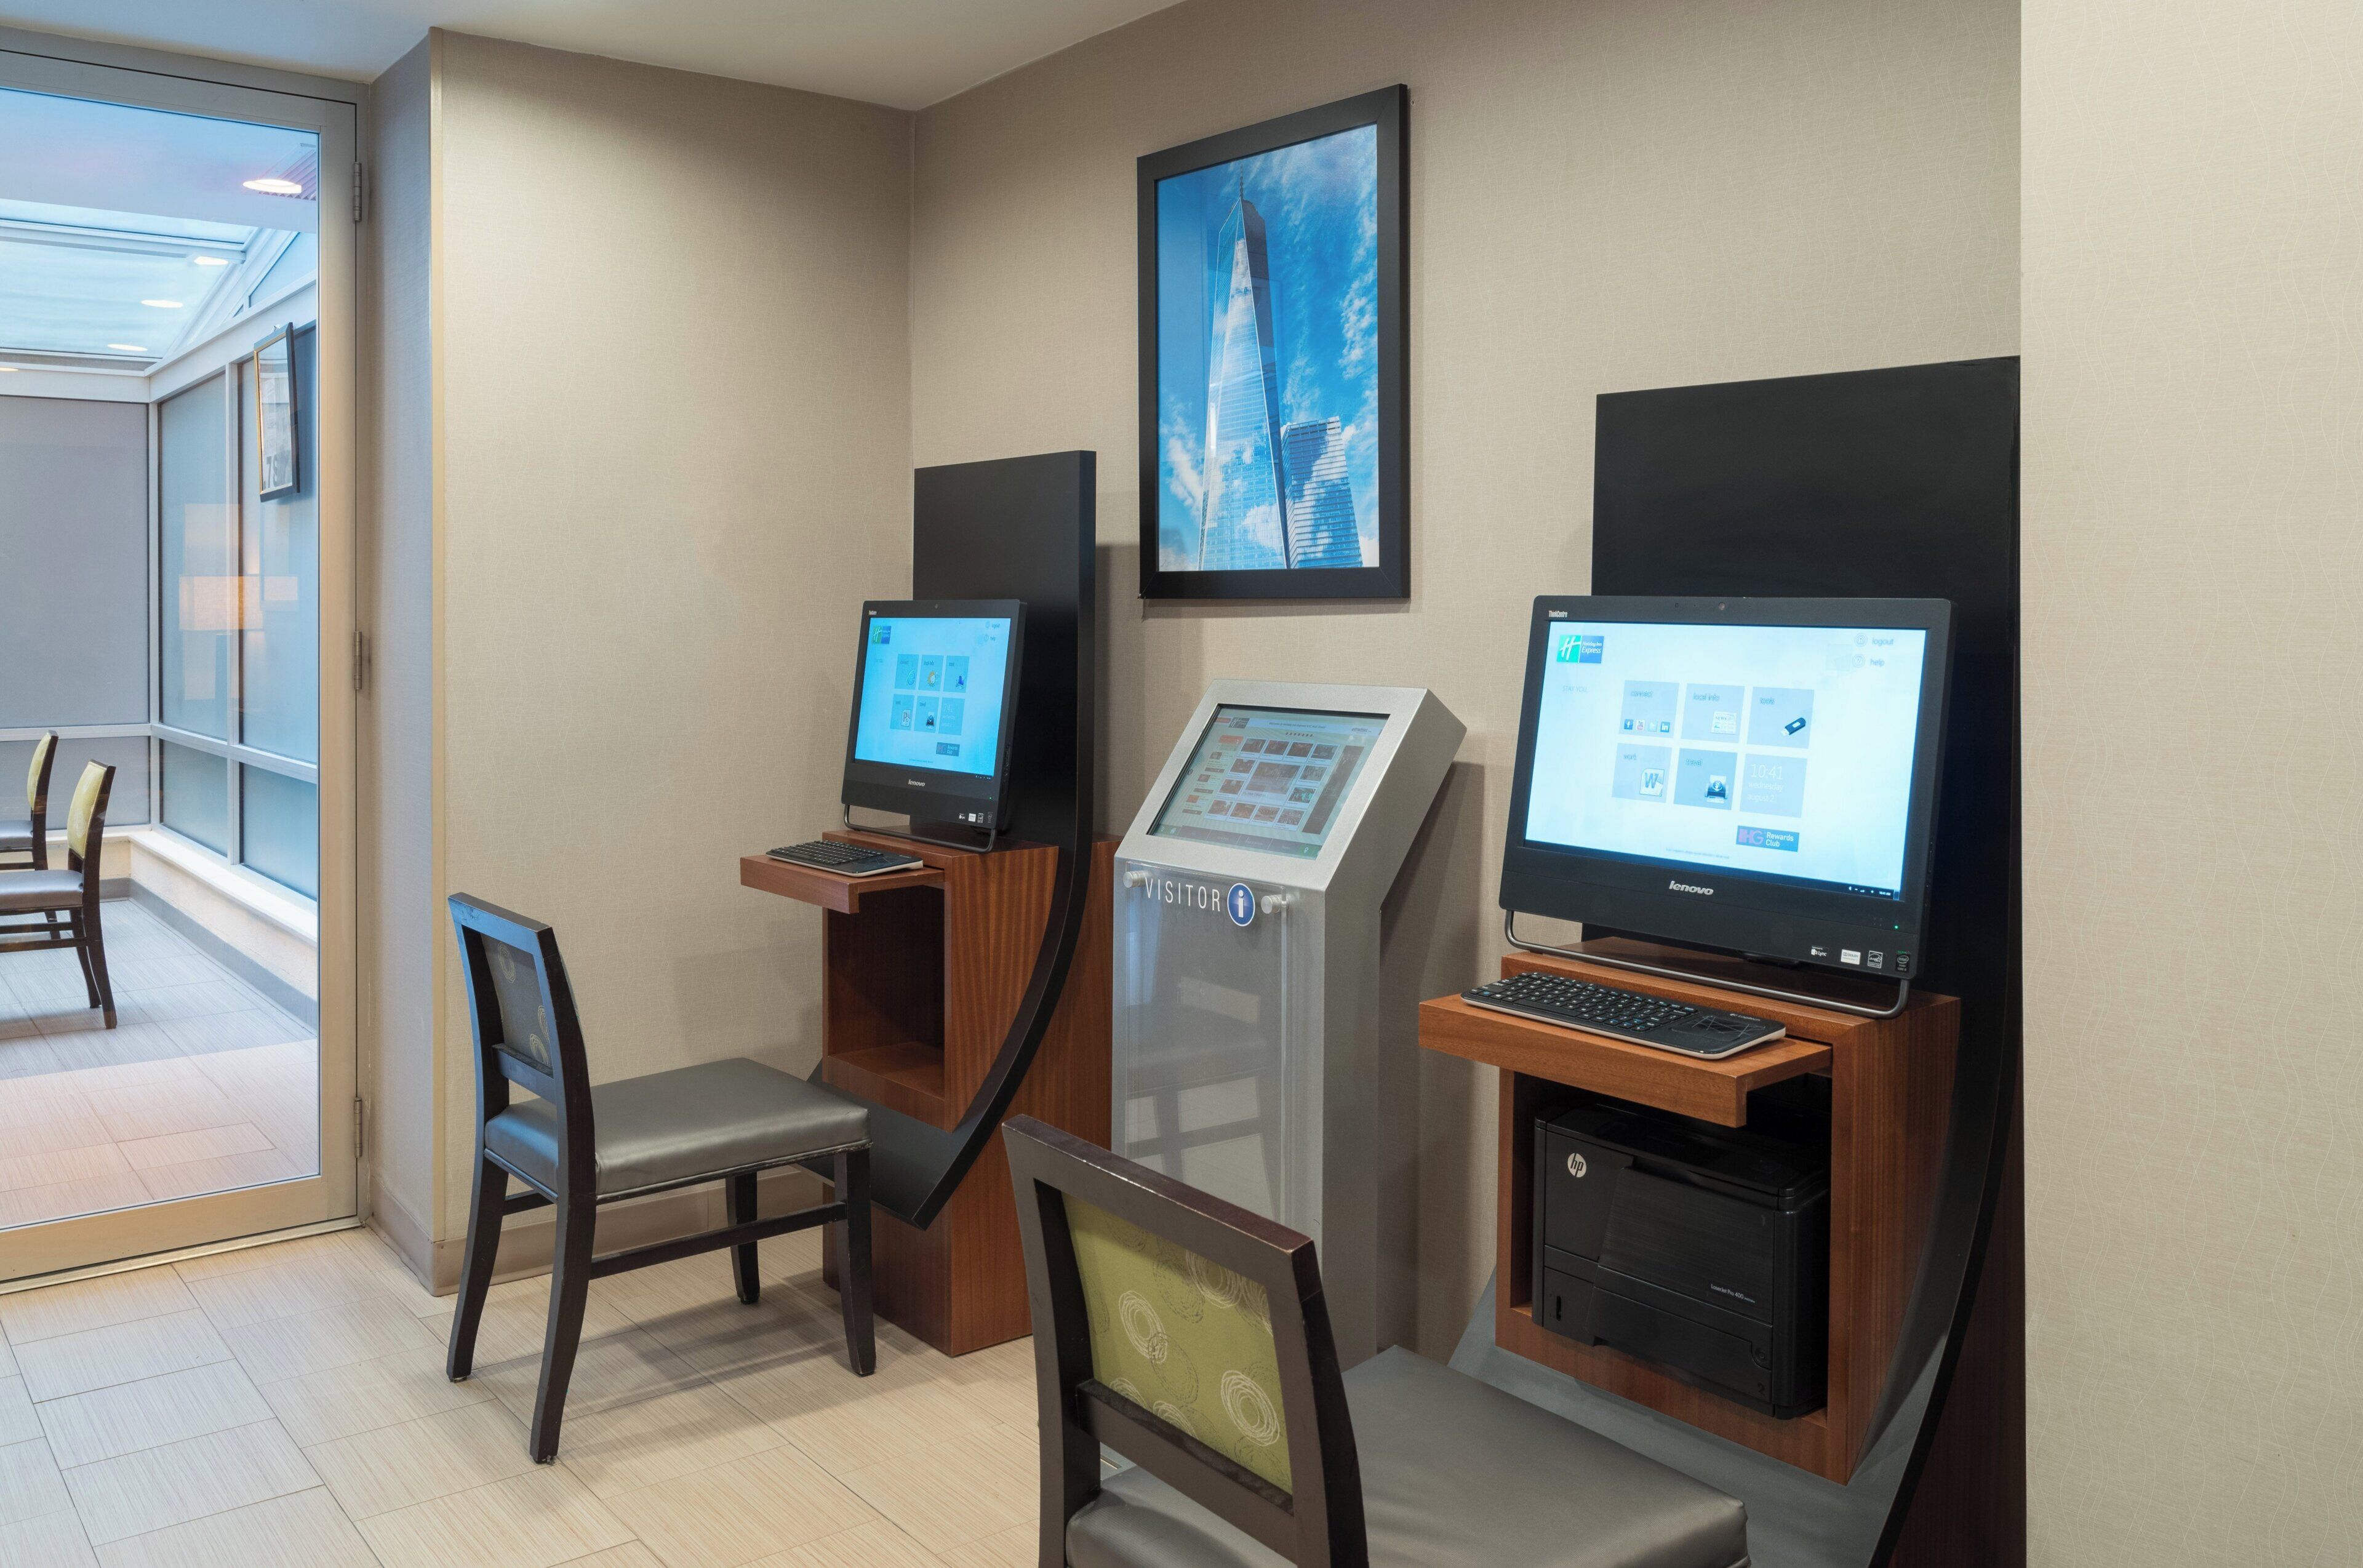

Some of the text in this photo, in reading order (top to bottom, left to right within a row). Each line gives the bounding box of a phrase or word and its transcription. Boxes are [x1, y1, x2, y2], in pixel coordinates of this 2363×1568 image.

[1872, 638, 1894, 646] logout
[1870, 658, 1885, 667] help
[1631, 690, 1653, 698] connect
[1708, 694, 1720, 702] info
[1751, 763, 1783, 780] 10:41
[908, 779, 926, 787] lenovo
[1748, 781, 1783, 792] wednesday
[1747, 793, 1768, 802] august
[1738, 828, 1764, 845] IHG
[1766, 832, 1794, 841] Rewards
[1669, 881, 1714, 895] lenovo
[1145, 877, 1220, 912] VISITOR
[1570, 1153, 1584, 1177] hp
[1711, 1283, 1727, 1294] LaserJet
